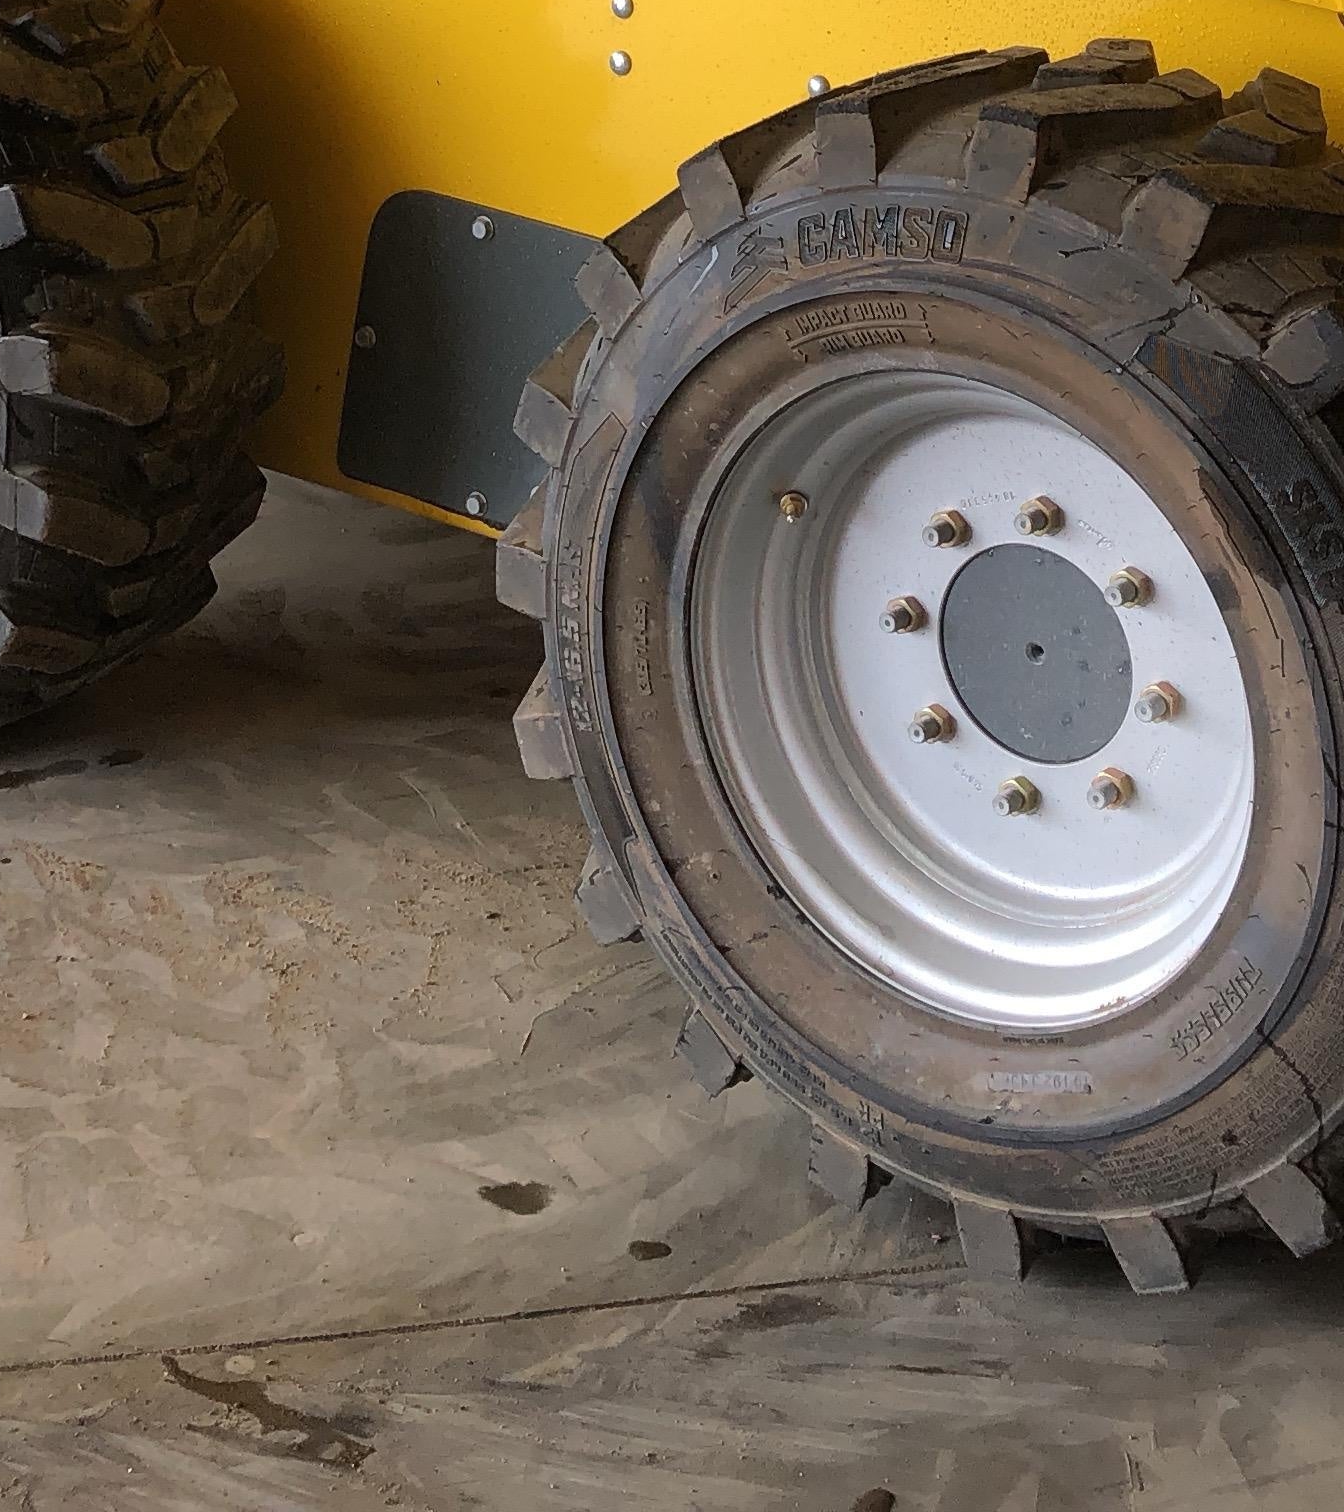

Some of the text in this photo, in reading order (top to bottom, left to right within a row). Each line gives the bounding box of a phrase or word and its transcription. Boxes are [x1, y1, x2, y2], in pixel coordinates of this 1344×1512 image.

[796, 203, 970, 270] CAMSO
[795, 301, 908, 336] IMPACT GUARD
[852, 327, 907, 349] GUARD
